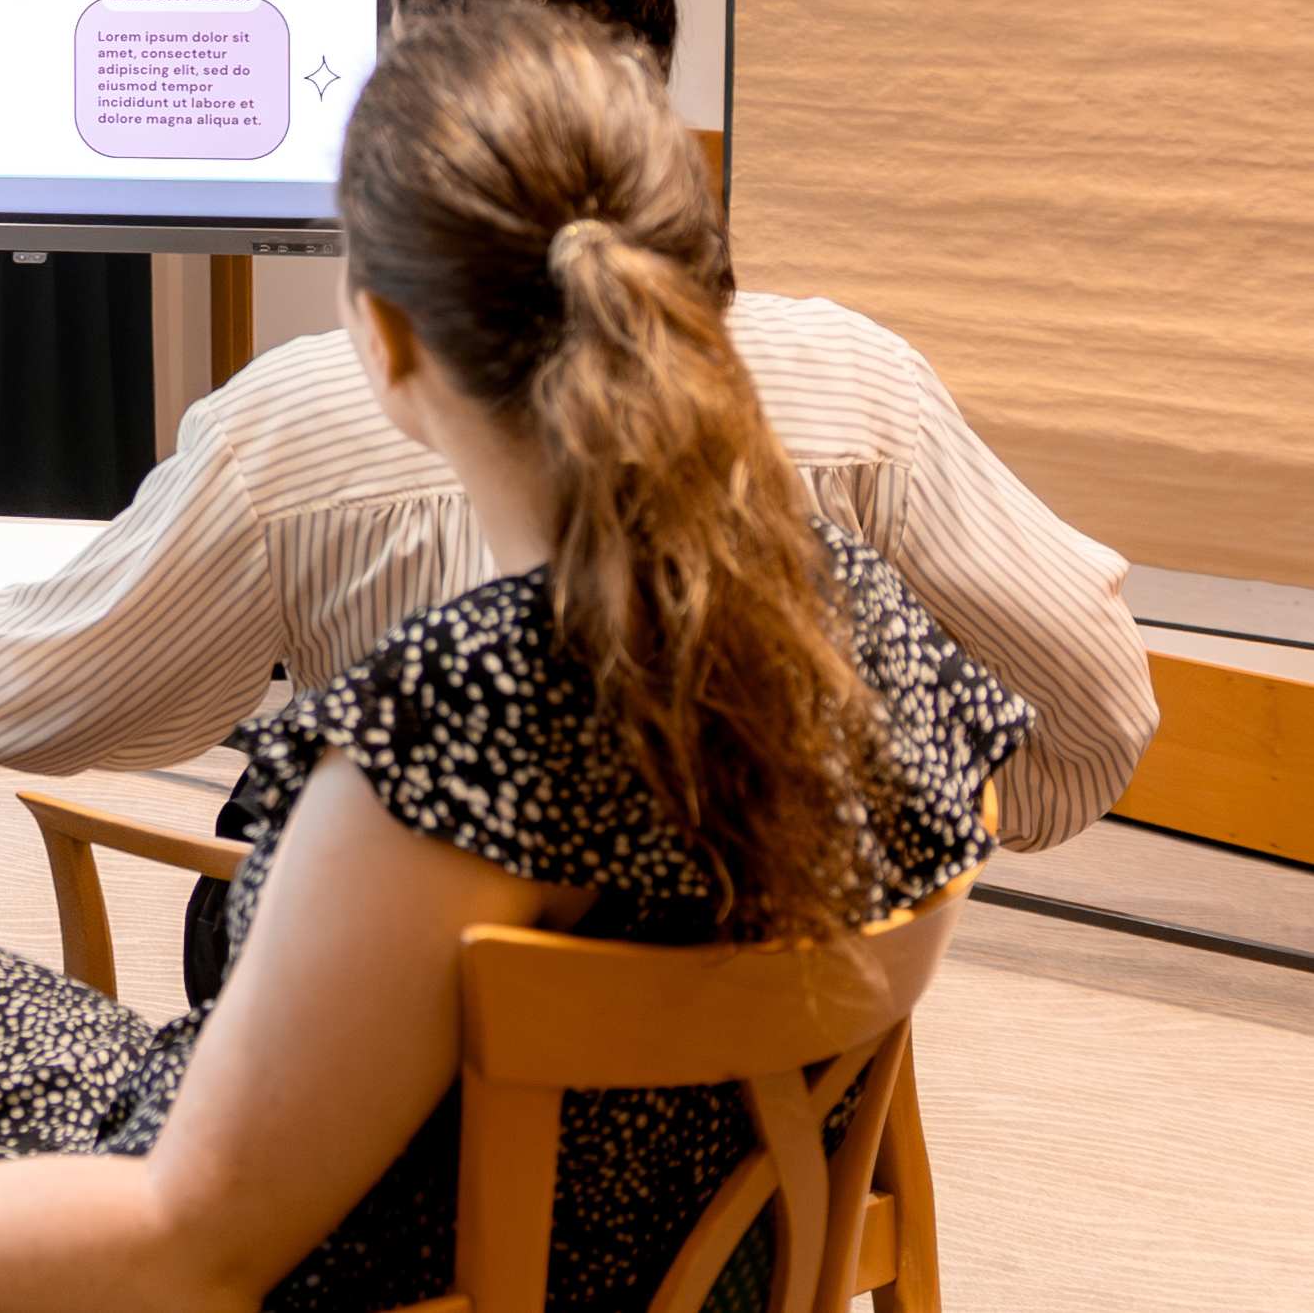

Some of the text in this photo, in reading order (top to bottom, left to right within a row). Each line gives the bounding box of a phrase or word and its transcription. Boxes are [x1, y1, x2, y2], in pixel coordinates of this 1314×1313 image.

[97, 30, 250, 46] Lorem ipsum dolor sit
[97, 48, 228, 60] amet, consectetur
[97, 63, 251, 79] adipiscing elit, sed do
[97, 79, 214, 95] eiusmod tempor
[97, 95, 255, 110] incididunt ut labore et
[97, 112, 262, 129] dolore magna aliqua et.
